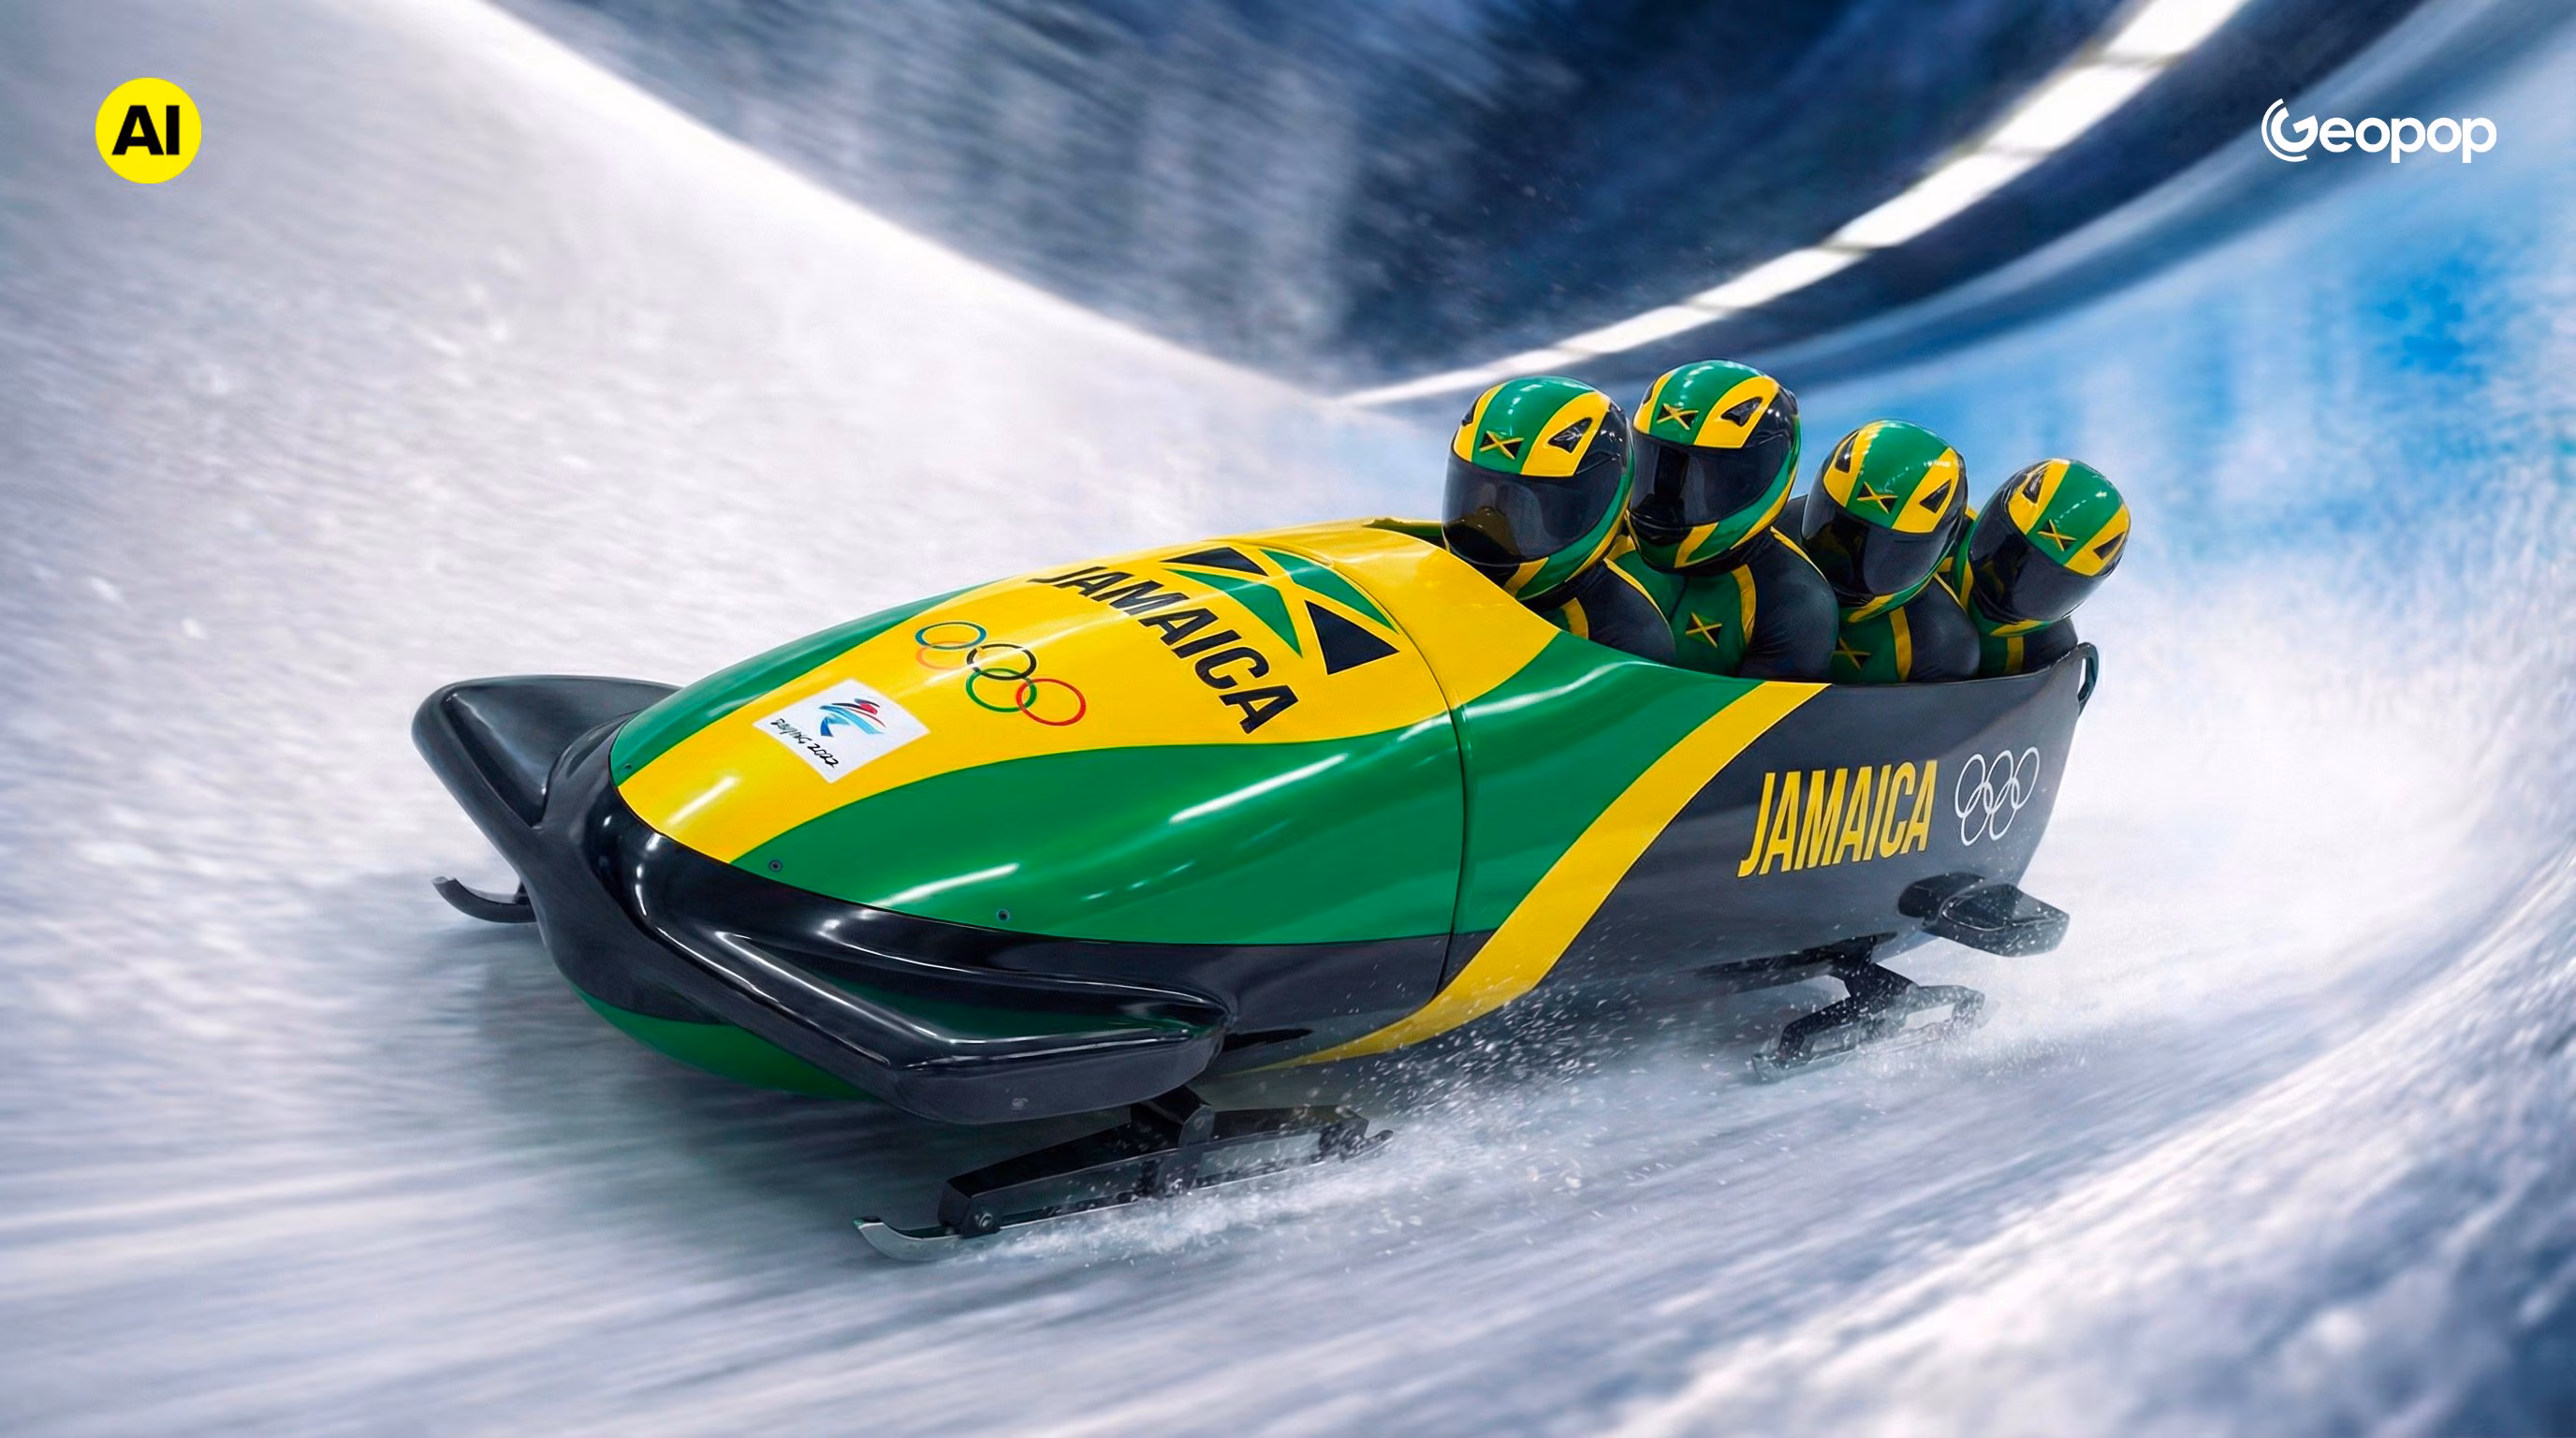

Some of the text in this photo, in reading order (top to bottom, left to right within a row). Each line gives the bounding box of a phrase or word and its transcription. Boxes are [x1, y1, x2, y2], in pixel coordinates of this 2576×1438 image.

[1028, 566, 1299, 734] JAMAICA
[807, 743, 839, 768] 2022
[1737, 759, 1938, 877] JAMAICA
